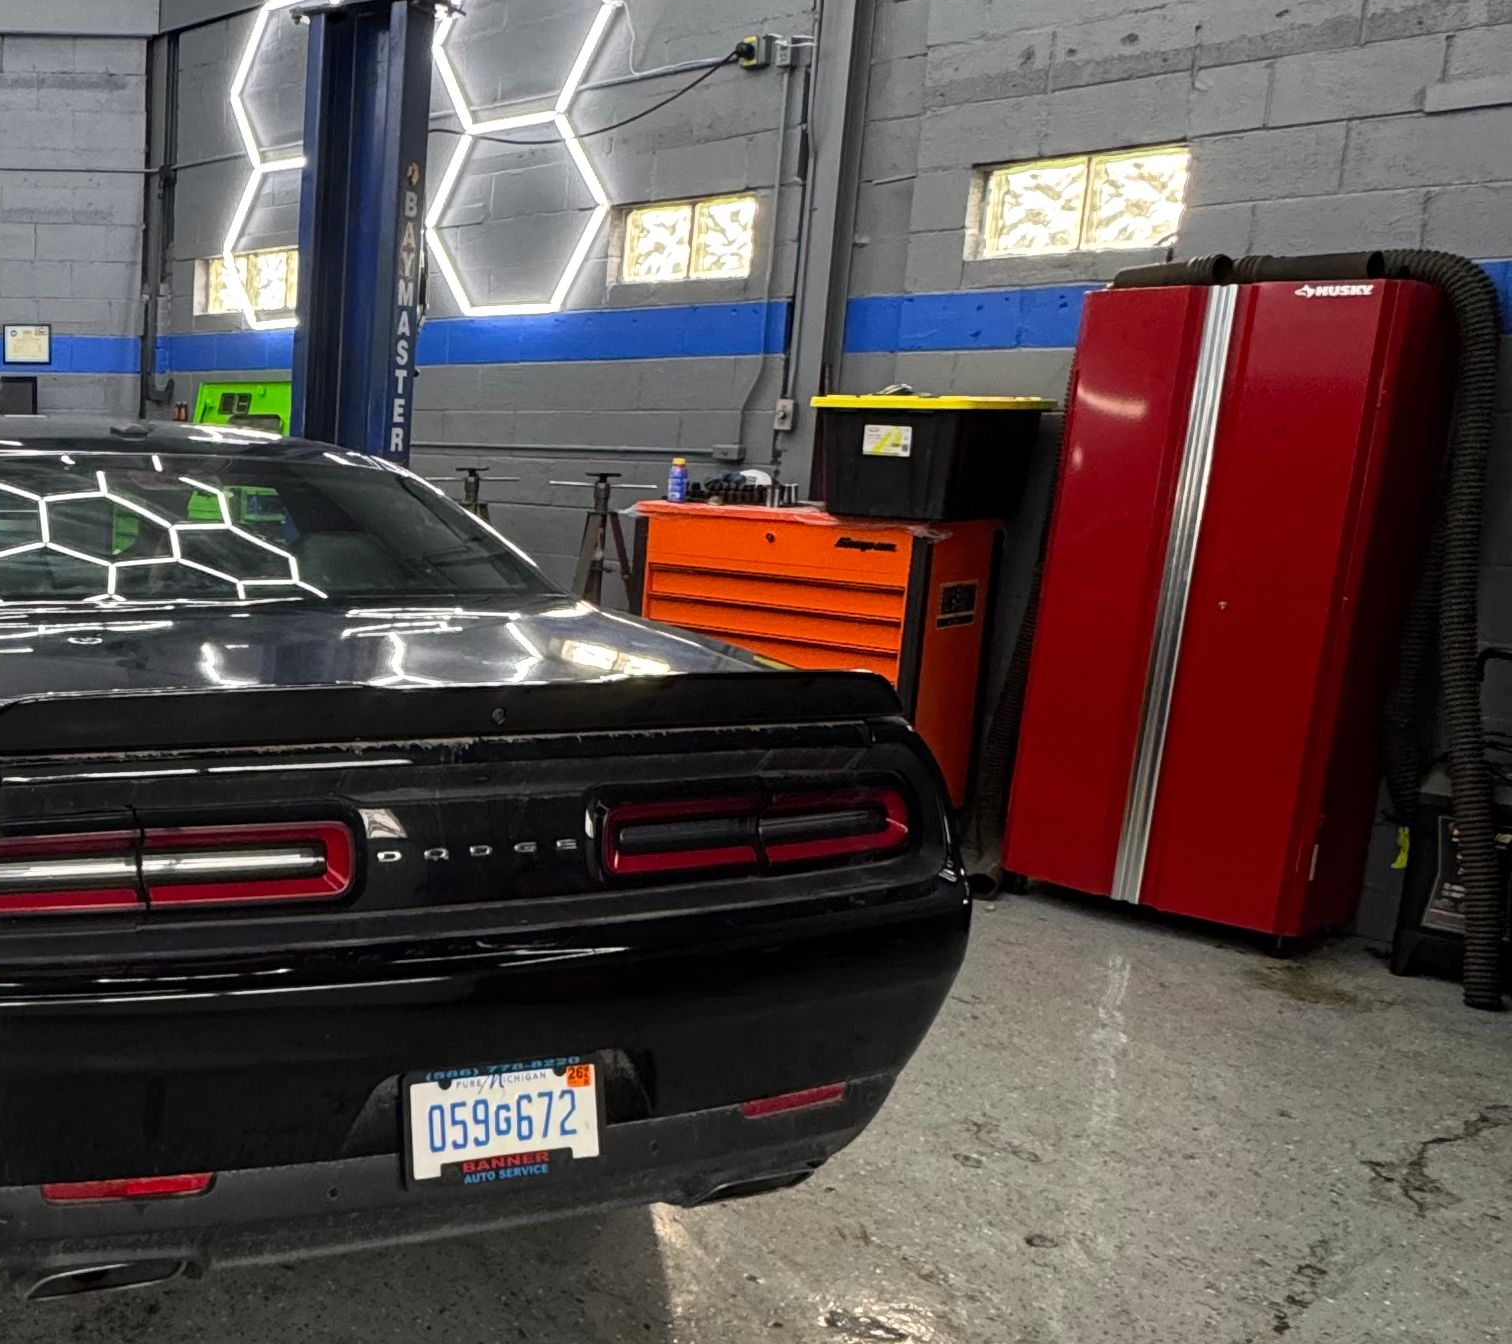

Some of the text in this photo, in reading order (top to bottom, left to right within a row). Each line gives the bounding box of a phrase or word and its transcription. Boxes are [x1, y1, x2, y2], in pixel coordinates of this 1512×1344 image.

[1314, 285, 1374, 297] HUSKY
[390, 191, 418, 453] BAYMASTER
[377, 839, 578, 862] DODGE
[455, 1071, 547, 1093] PURE MICHIGAN
[567, 1066, 584, 1080] 26
[428, 1089, 577, 1153] 059G672
[462, 1151, 550, 1174] BANNER
[464, 1163, 549, 1185] AUTO SERVICE
